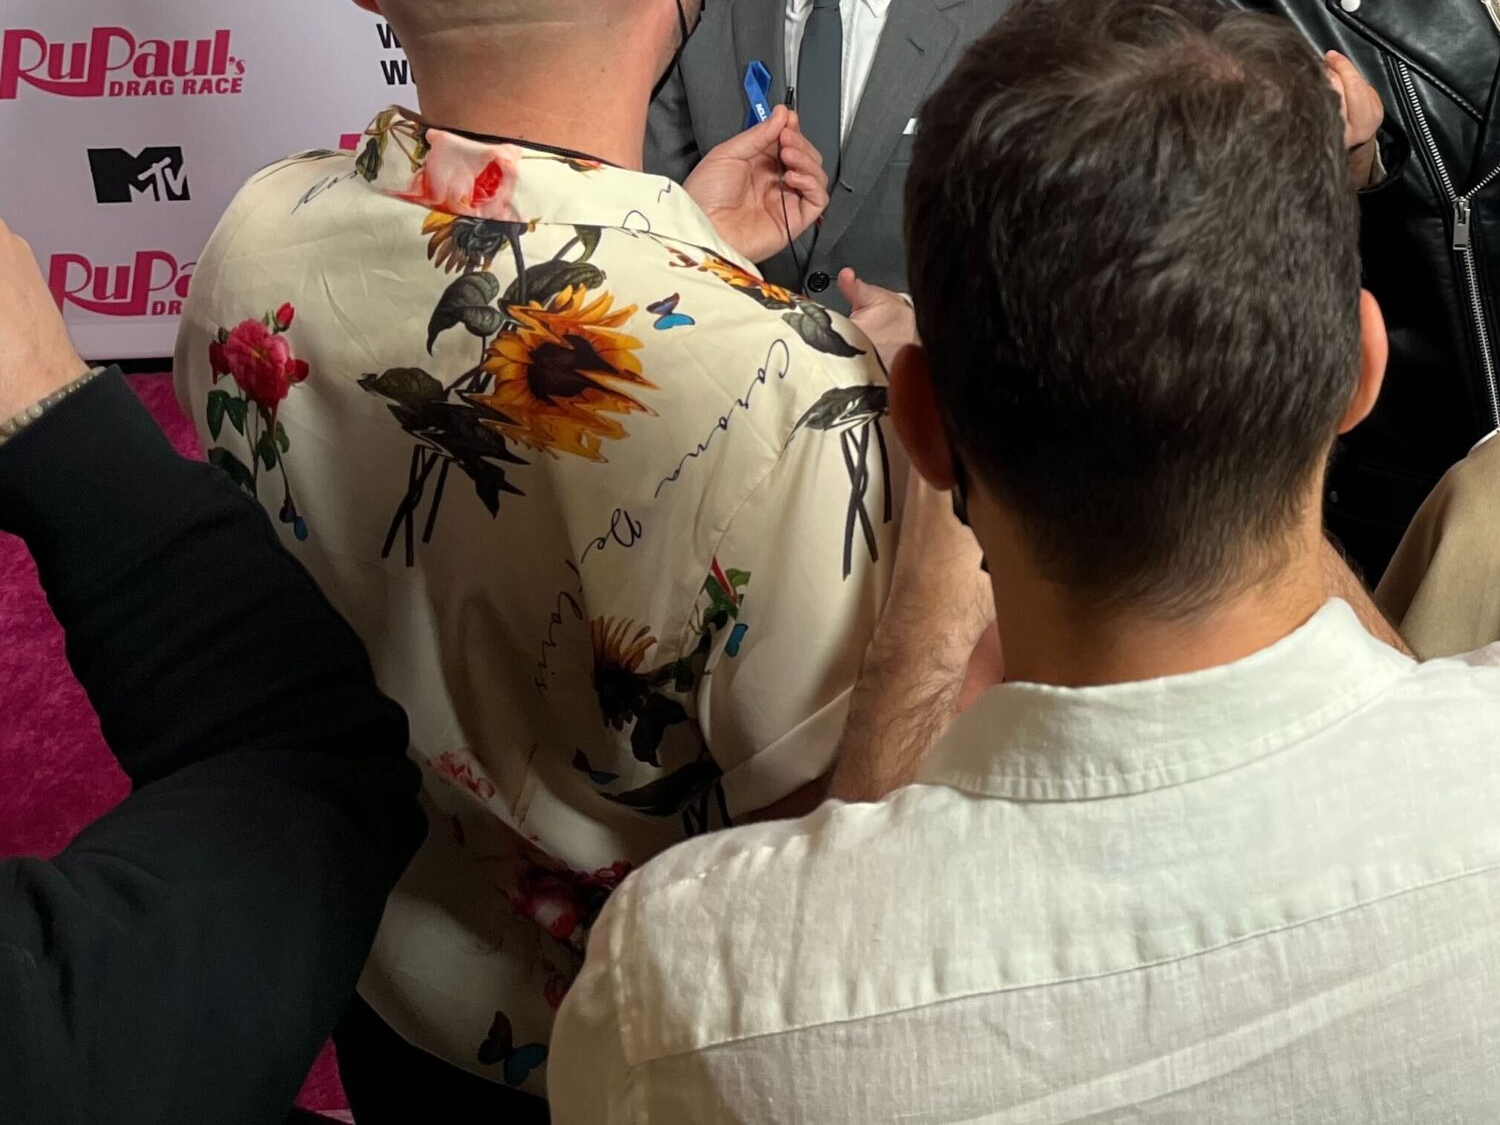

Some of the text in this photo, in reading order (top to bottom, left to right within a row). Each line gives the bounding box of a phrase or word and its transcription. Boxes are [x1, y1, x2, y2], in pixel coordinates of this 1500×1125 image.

[0, 27, 246, 100] RuPaul's
[109, 77, 243, 98] DRAG RACE
[87, 145, 191, 204] MTV
